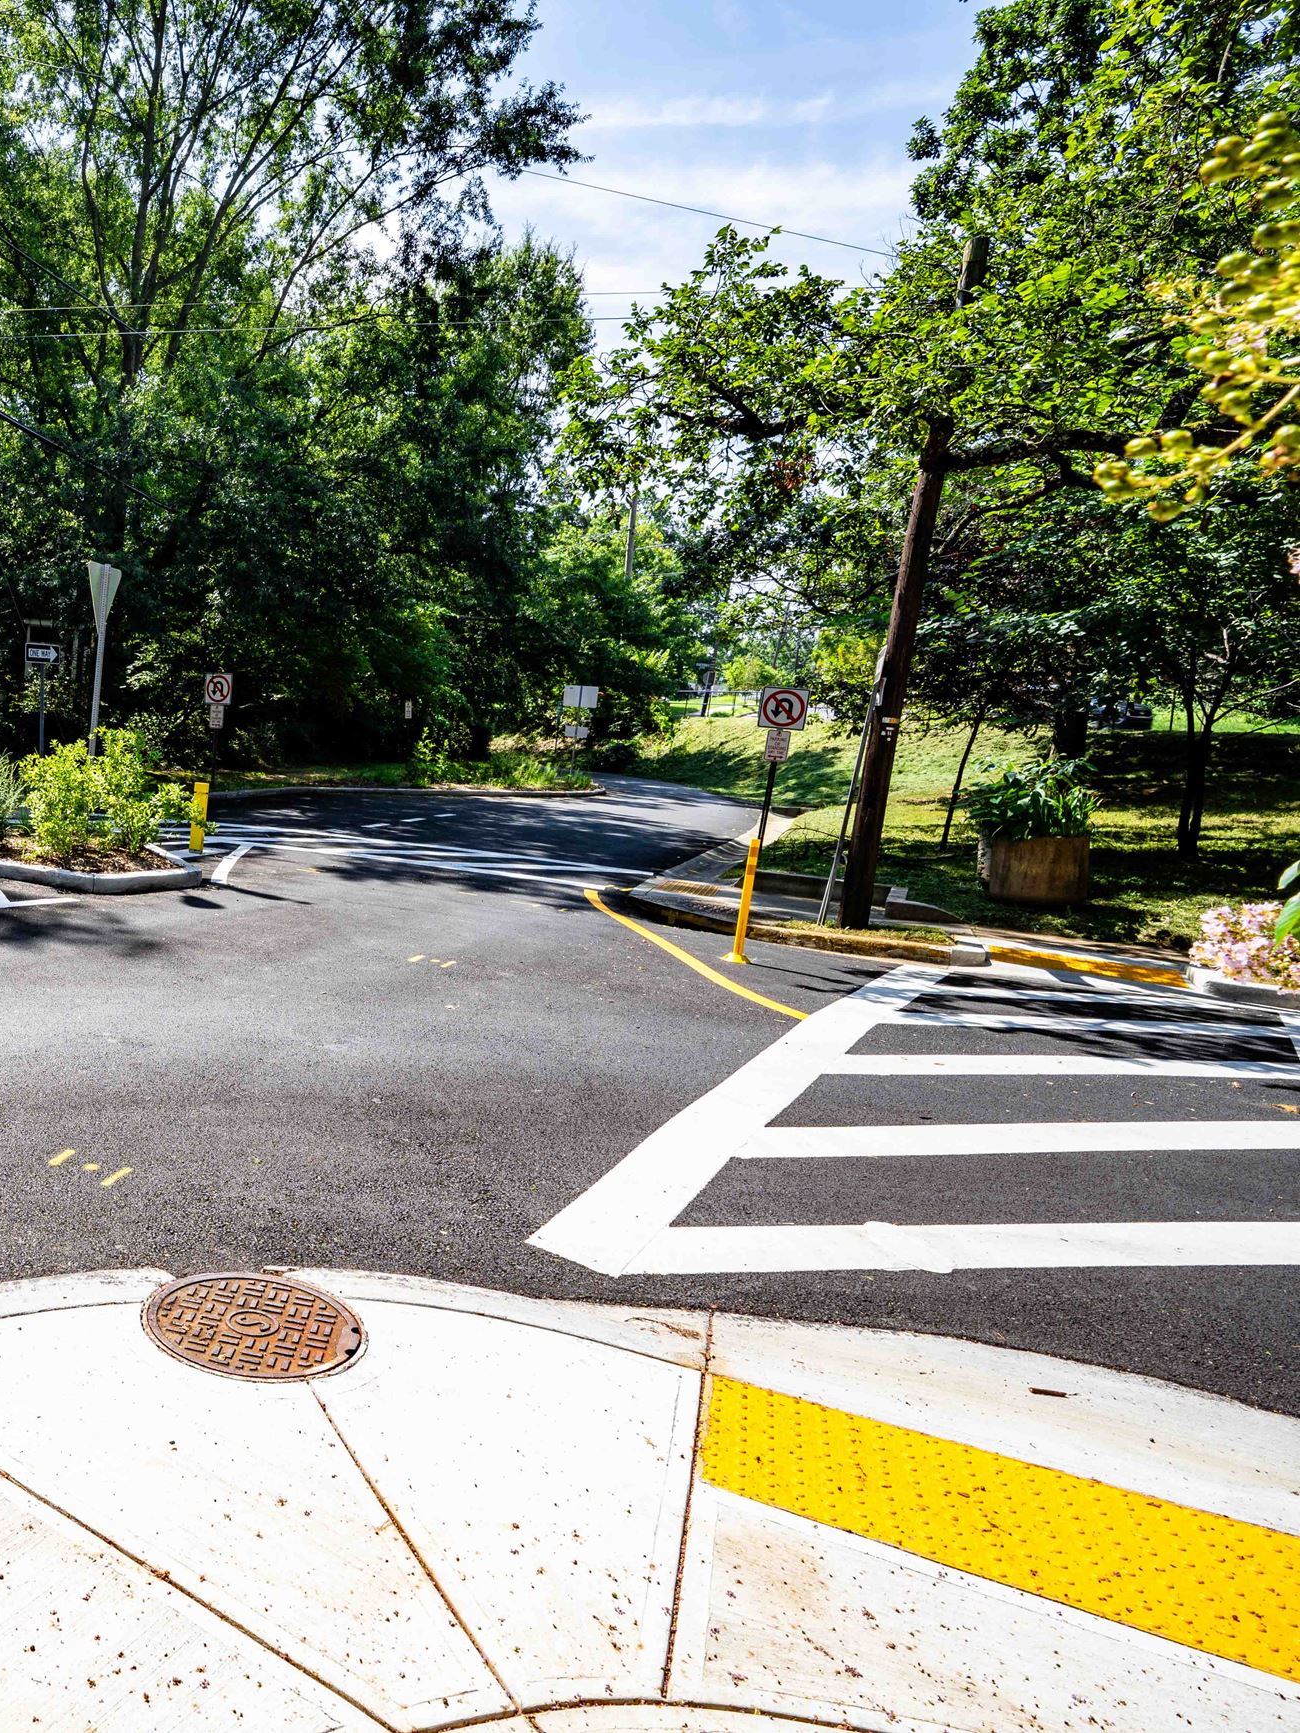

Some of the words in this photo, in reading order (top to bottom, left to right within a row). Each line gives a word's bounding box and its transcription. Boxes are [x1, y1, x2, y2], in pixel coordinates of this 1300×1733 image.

[29, 648, 40, 657] ONE
[40, 649, 51, 658] WAY
[234, 1314, 271, 1333] S
